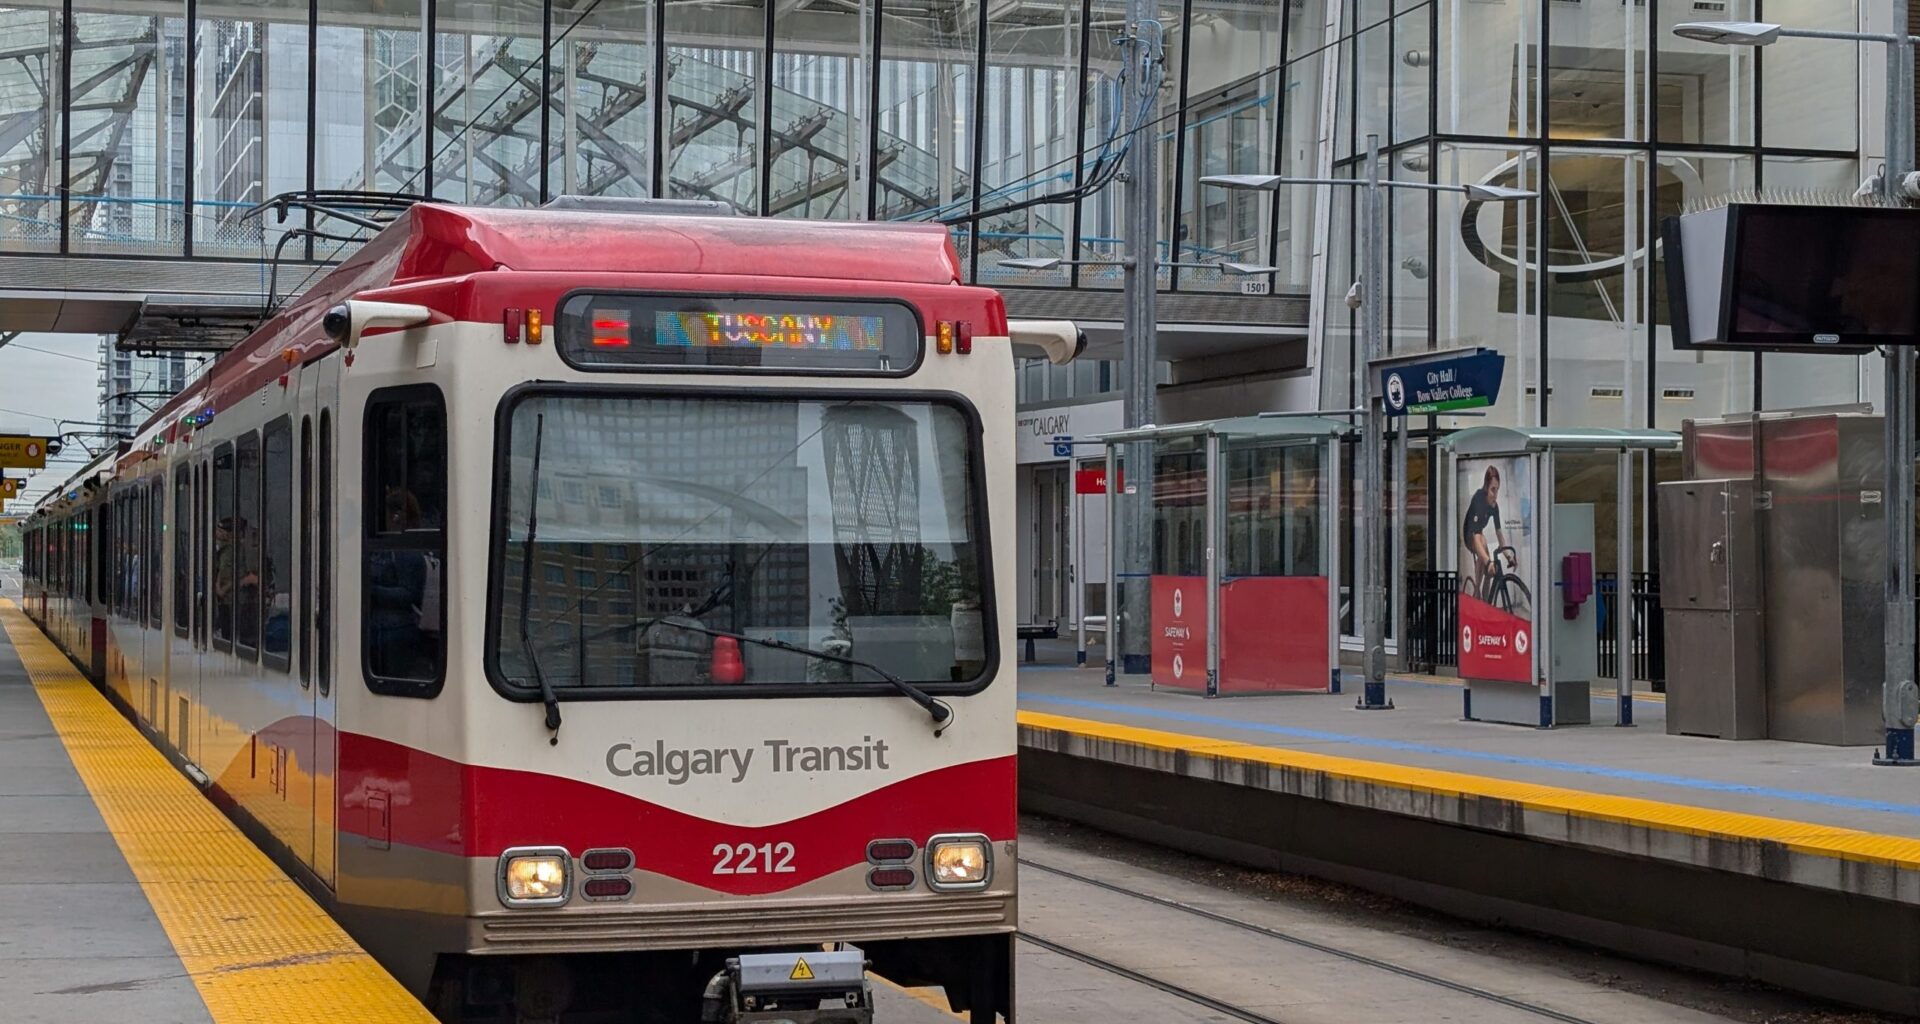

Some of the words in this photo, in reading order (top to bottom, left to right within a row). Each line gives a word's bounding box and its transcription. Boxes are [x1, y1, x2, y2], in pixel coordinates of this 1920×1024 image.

[1247, 283, 1265, 292] 1501
[707, 314, 833, 342] TUSCANY
[1427, 372, 1439, 387] City
[1440, 368, 1453, 382] Hall
[1417, 390, 1430, 403] Bow
[1430, 387, 1448, 403] Valley
[1449, 385, 1473, 400] College
[1033, 415, 1069, 436] CALGARY
[1096, 478, 1106, 486] Ho
[1165, 627, 1185, 637] SAFEWAY
[1478, 635, 1501, 645] SAFEWAY
[606, 739, 754, 785] Calgary
[764, 736, 889, 772] Transit
[712, 842, 795, 874] 2212
